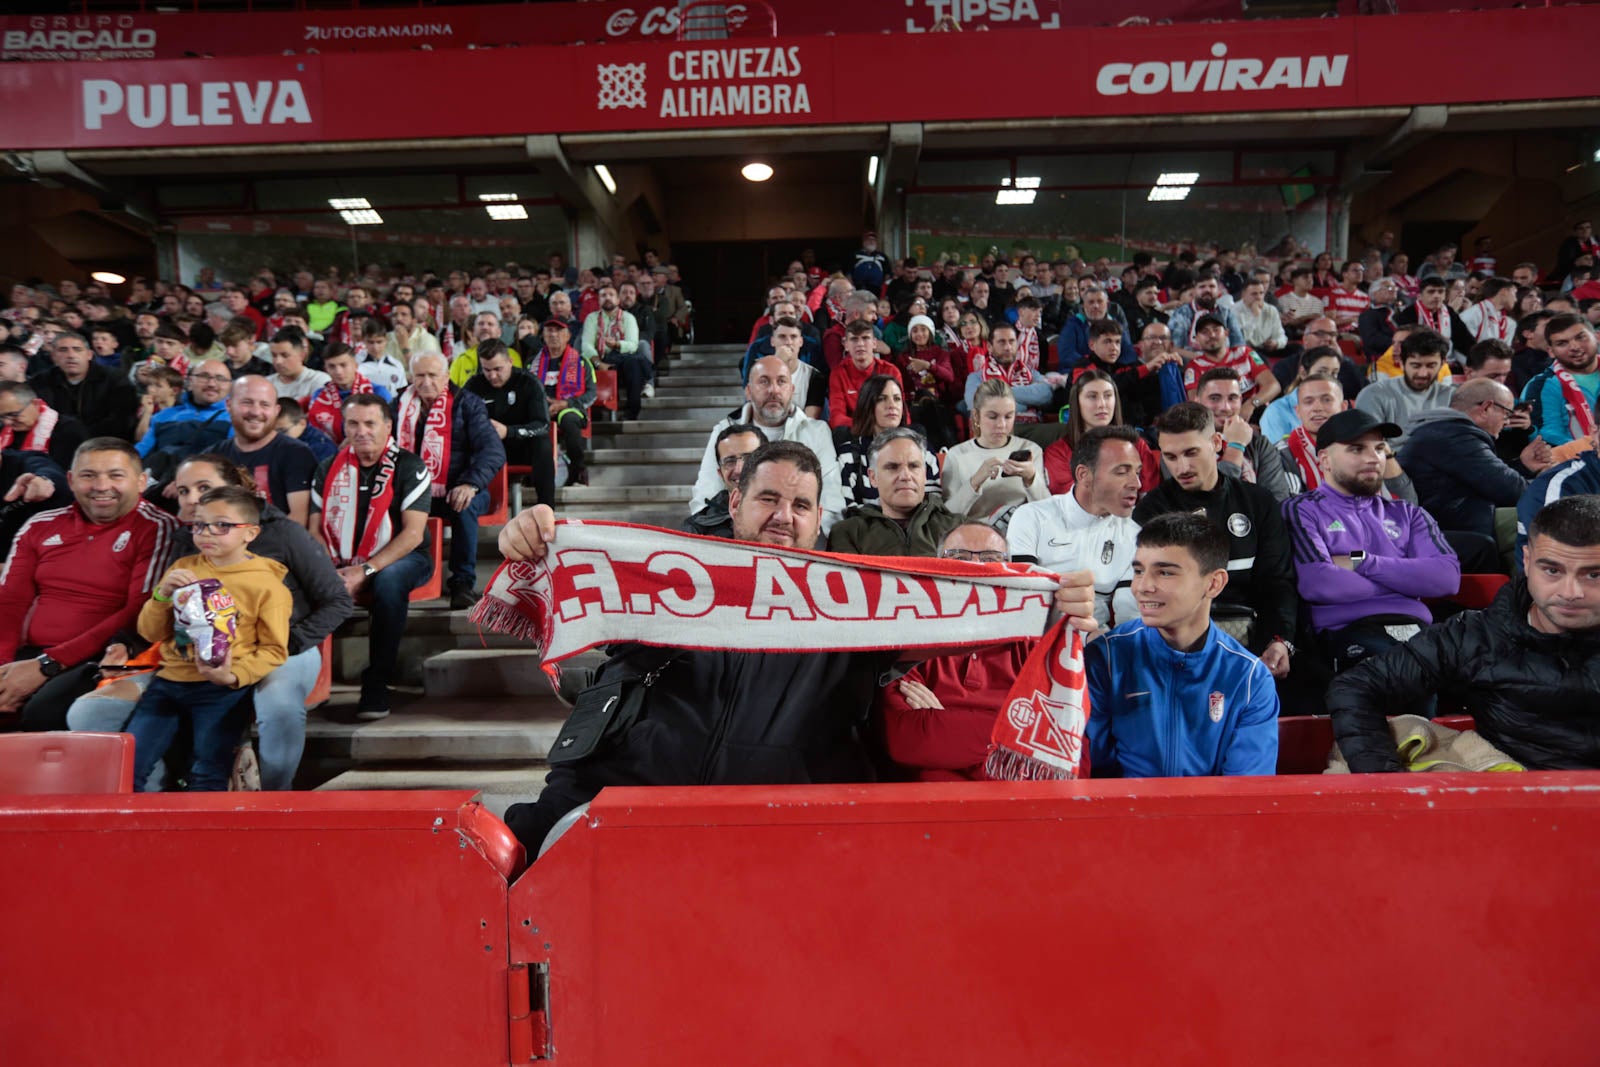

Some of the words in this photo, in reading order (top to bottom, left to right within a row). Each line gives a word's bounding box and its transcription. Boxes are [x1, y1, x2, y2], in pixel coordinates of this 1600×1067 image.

[29, 15, 134, 29] GRUPO
[925, 0, 1039, 22] TIPSA
[3, 29, 157, 49] BARCALO
[303, 23, 453, 40] AUTOGRANADINA
[668, 46, 802, 81] CERVEZAS
[1096, 42, 1349, 95] COVIRAN
[82, 79, 312, 129] PULEVA
[659, 83, 811, 118] ALHAMBRA
